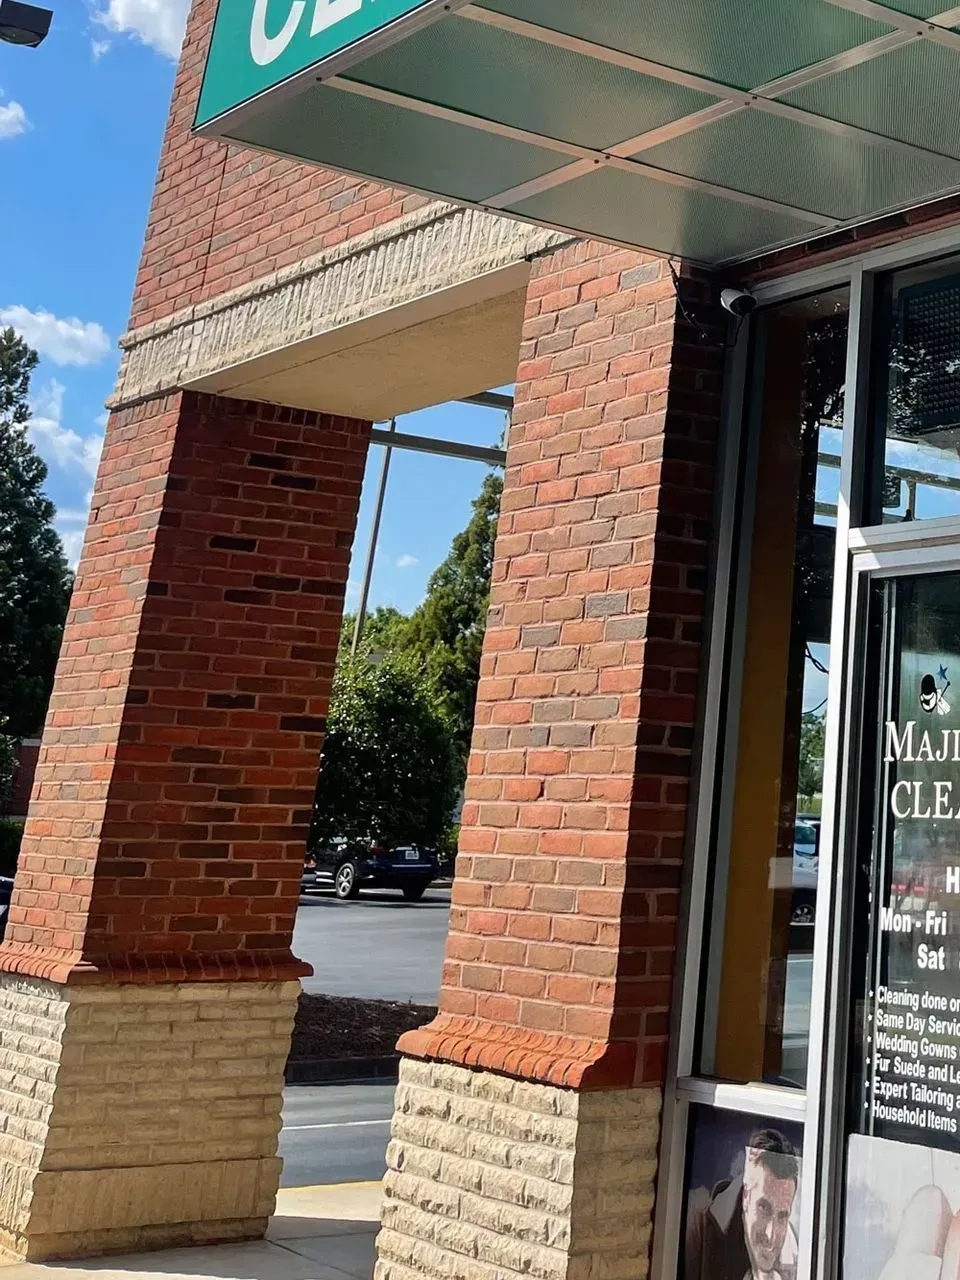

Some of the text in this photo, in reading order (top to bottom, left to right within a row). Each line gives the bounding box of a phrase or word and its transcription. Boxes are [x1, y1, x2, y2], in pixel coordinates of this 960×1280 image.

[880, 907, 912, 932] Mon
[925, 910, 947, 936] Fri
[917, 944, 945, 970] Sat
[876, 985, 919, 1011] Cleaning
[922, 991, 947, 1011] done
[876, 1008, 904, 1028] Same
[906, 1012, 927, 1036] Day
[876, 1031, 918, 1058] Wedding
[920, 1038, 957, 1060] Gowns
[873, 1053, 891, 1072] Fur
[894, 1056, 925, 1078] Suede
[928, 1063, 948, 1082] and
[873, 1076, 908, 1100] Expert
[910, 1082, 954, 1112] Tailoring
[872, 1099, 957, 1133] Household Items
